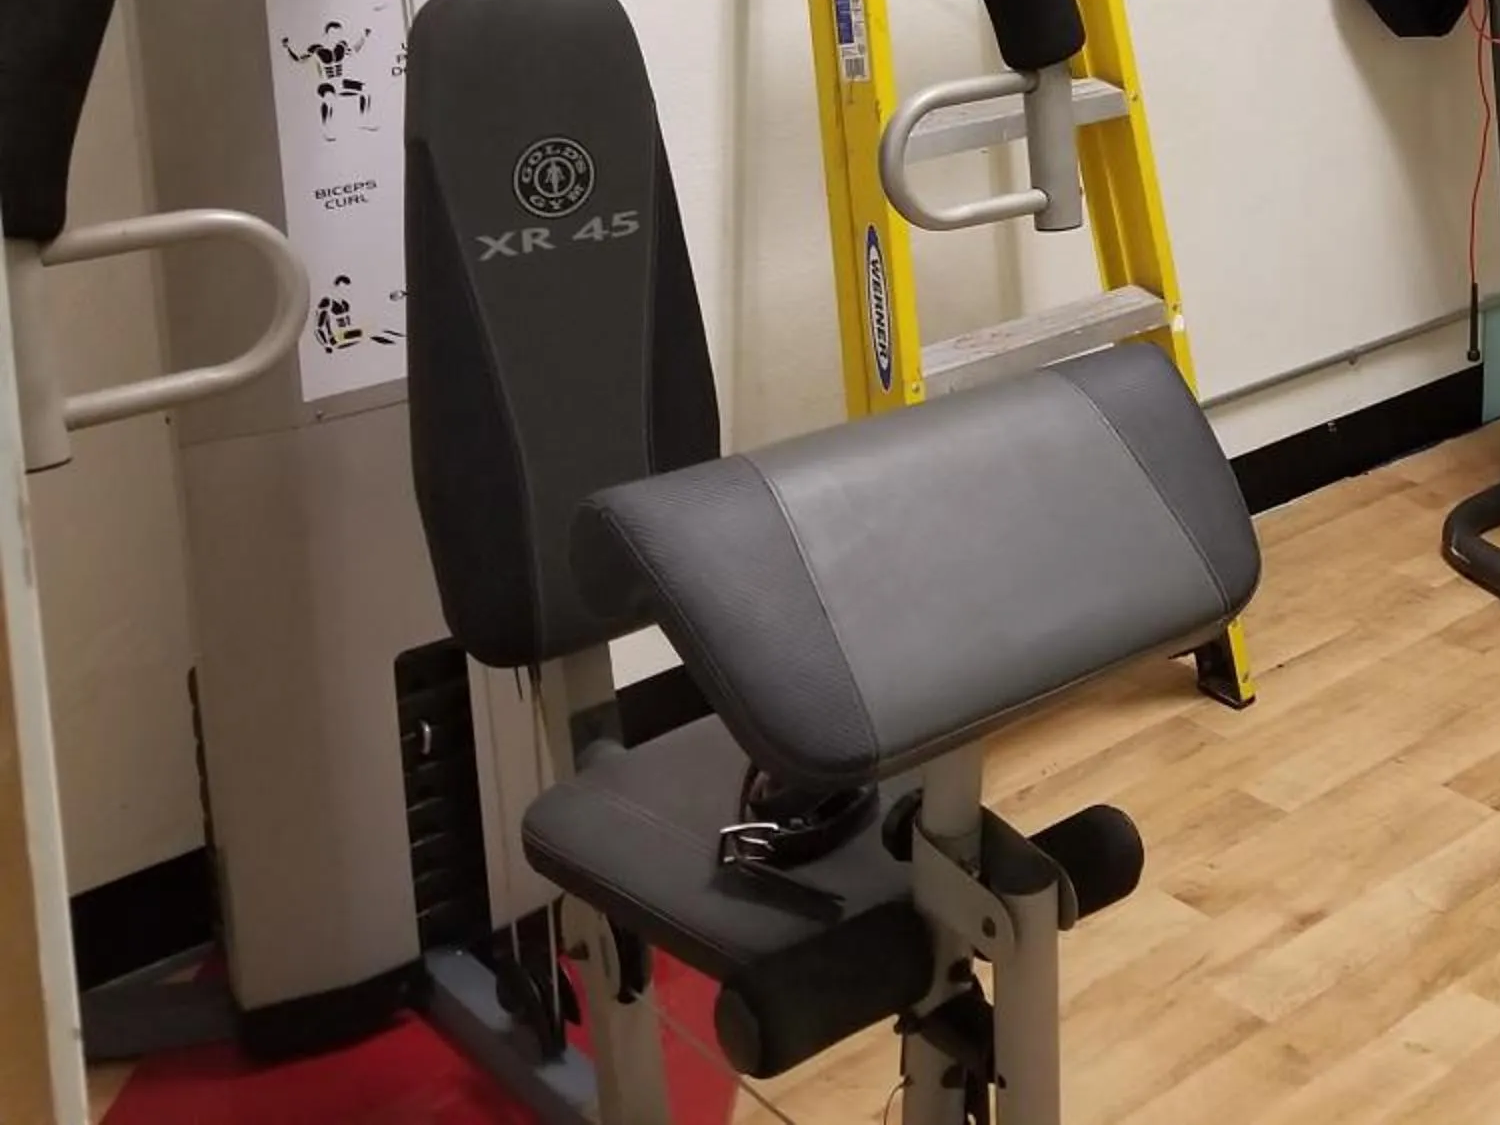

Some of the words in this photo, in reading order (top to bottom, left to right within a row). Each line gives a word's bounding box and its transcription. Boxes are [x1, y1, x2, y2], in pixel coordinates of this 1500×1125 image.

[521, 143, 587, 184] GOLD'S
[314, 179, 378, 200] BICEPS
[324, 193, 368, 210] CURL
[528, 183, 585, 210] GYM
[475, 227, 557, 262] XR
[572, 209, 640, 241] 45
[870, 258, 888, 358] WERNER
